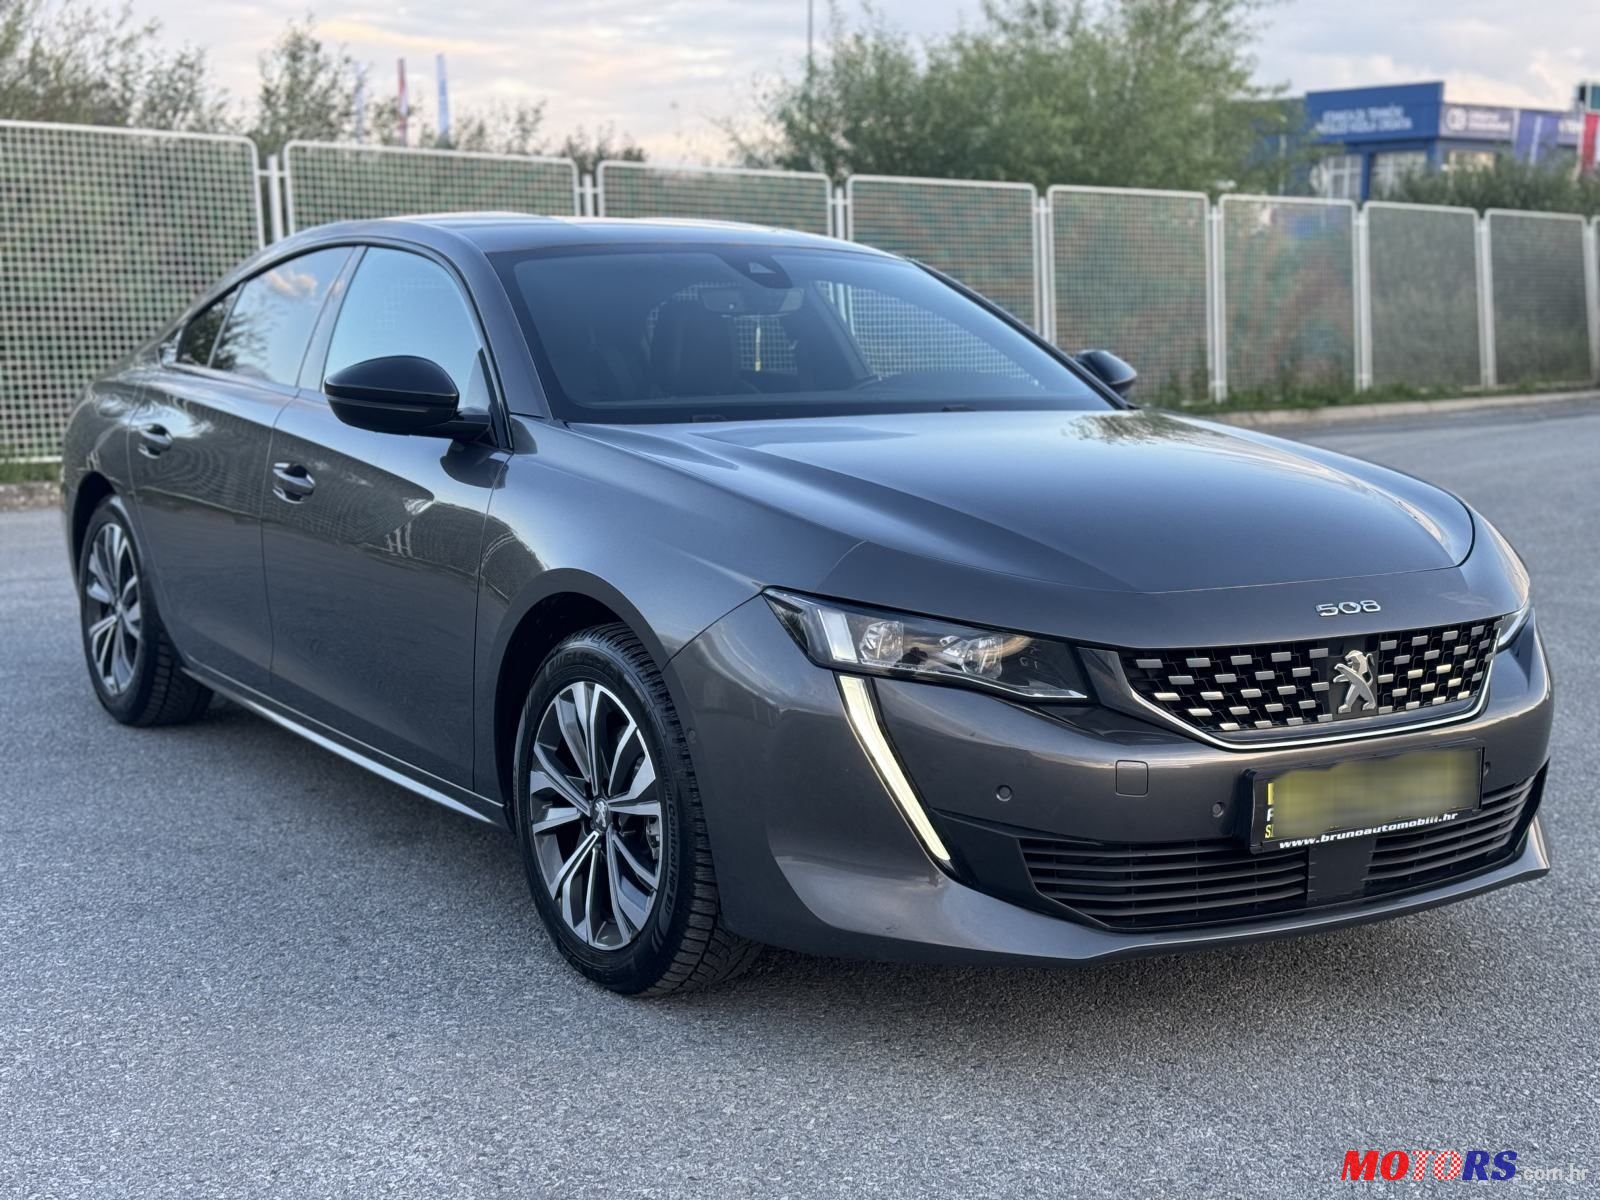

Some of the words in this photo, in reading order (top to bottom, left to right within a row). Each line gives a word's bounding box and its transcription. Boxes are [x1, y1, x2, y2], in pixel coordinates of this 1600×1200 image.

[1316, 600, 1381, 616] 508
[669, 803, 678, 868] Control
[1280, 813, 1458, 848] www.brunoautomobili.hr
